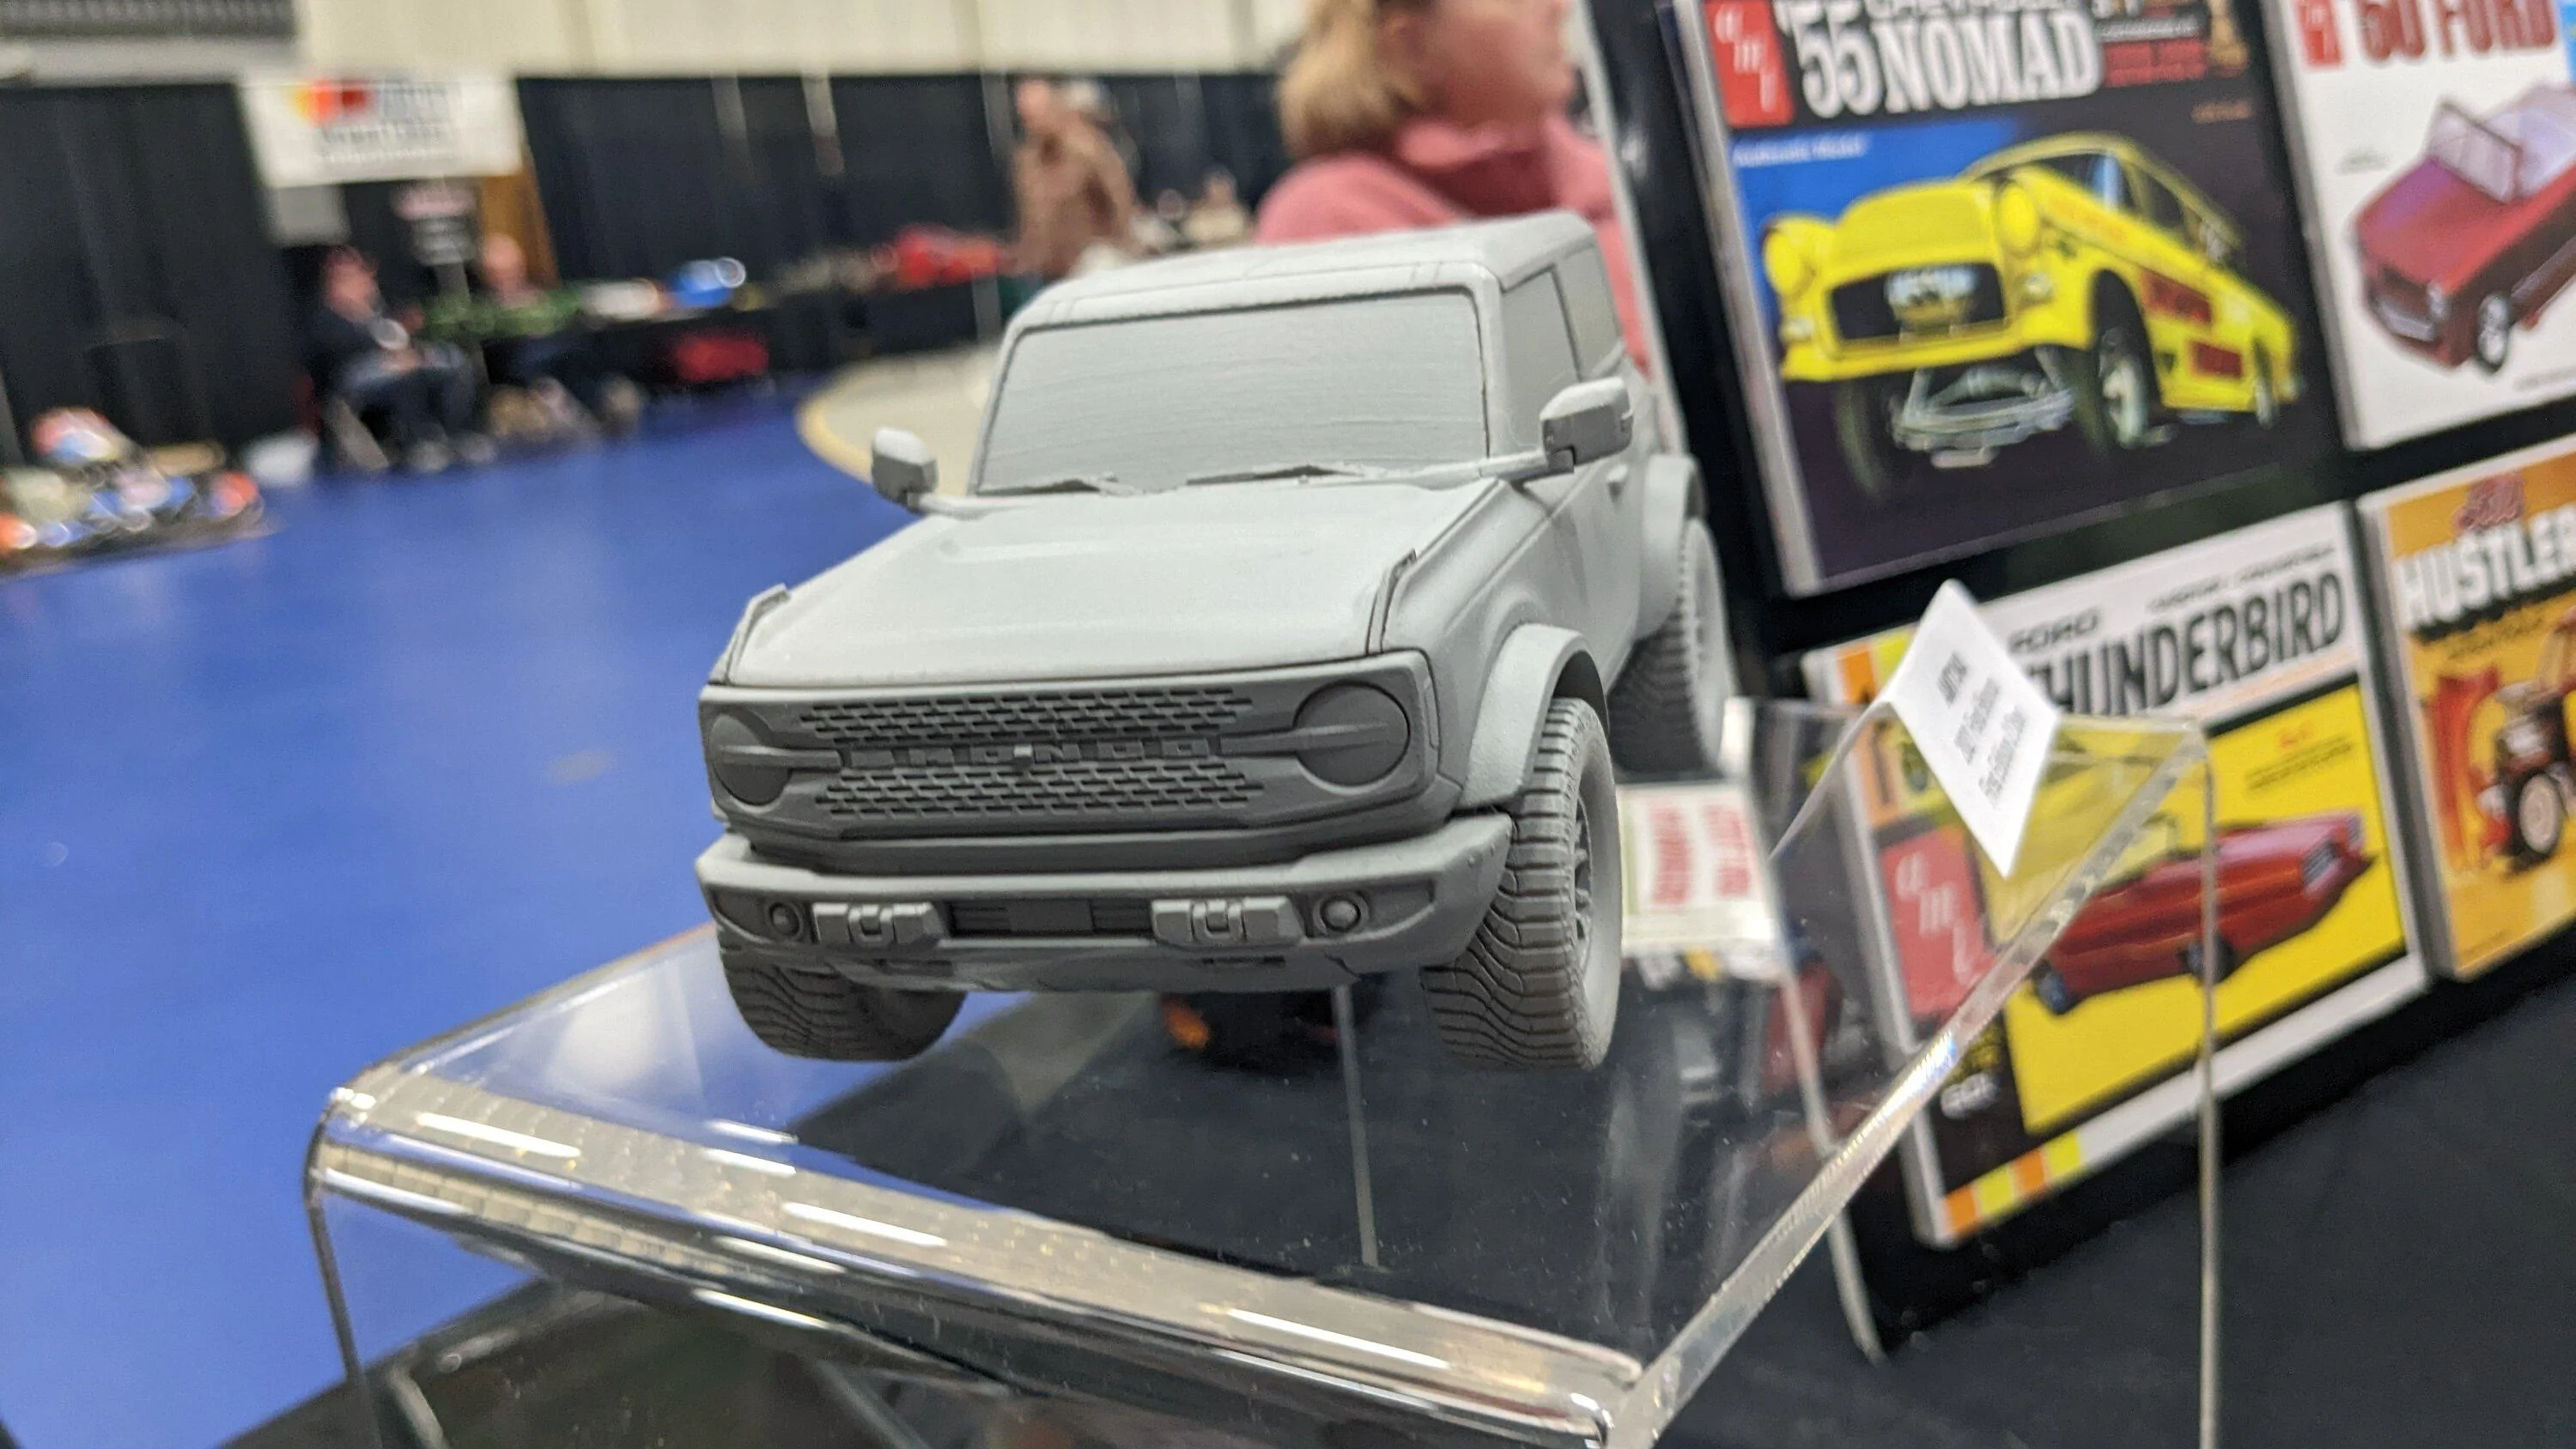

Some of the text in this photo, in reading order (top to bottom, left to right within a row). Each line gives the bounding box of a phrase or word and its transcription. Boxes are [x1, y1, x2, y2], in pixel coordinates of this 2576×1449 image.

[1874, 9, 2104, 113] NOMAD
[2007, 605, 2101, 654] FORD
[2025, 571, 2345, 717] HUNDERBIRD
